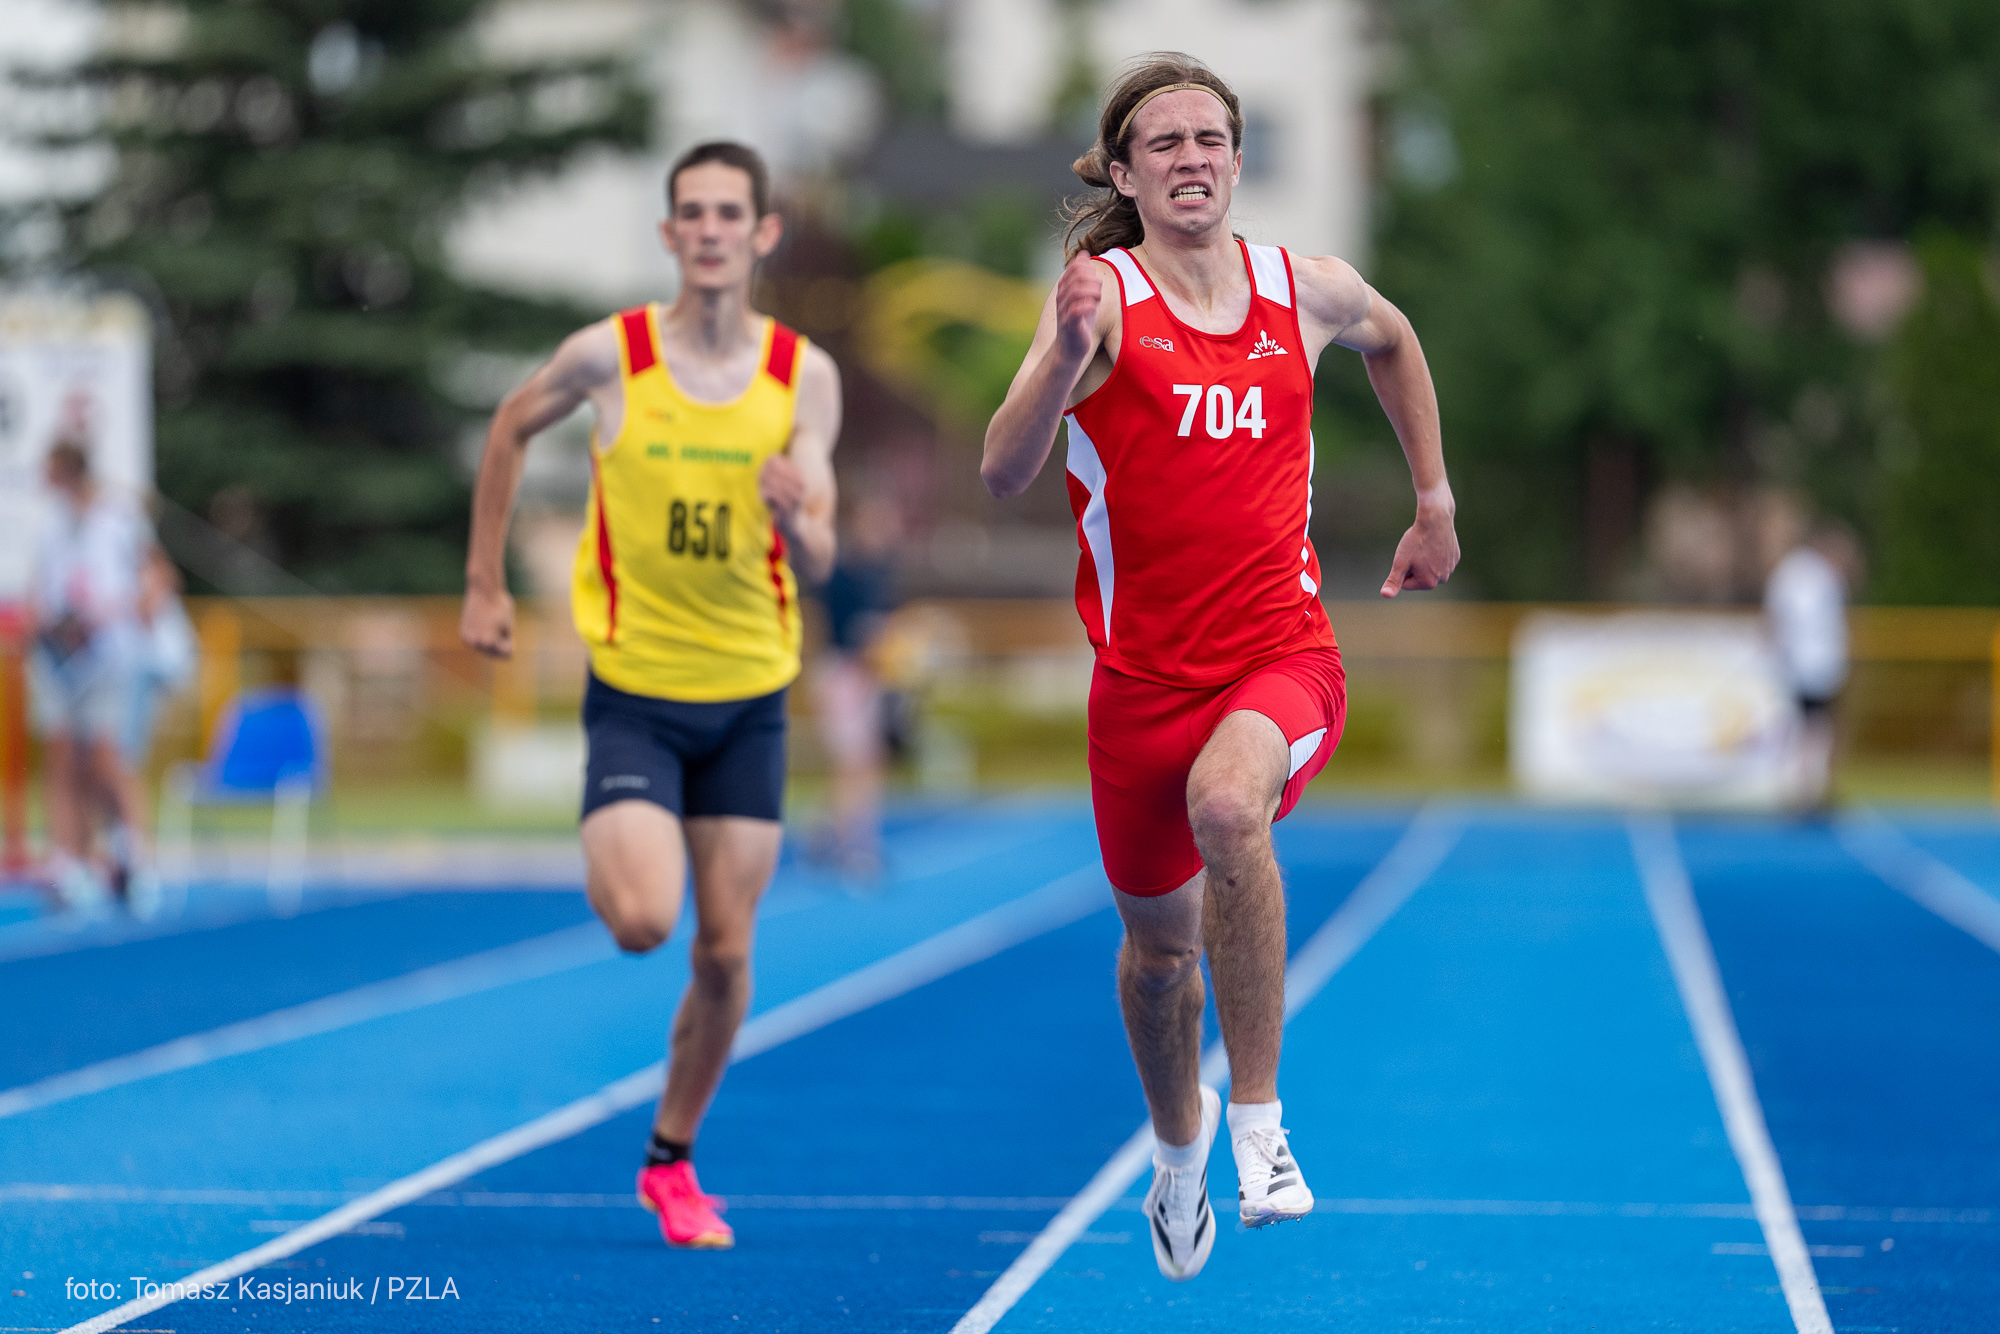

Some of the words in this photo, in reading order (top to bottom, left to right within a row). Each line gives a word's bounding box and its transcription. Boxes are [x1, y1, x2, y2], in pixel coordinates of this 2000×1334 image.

[1139, 335, 1175, 352] esa
[1173, 384, 1267, 439] 704
[668, 500, 731, 560] 850
